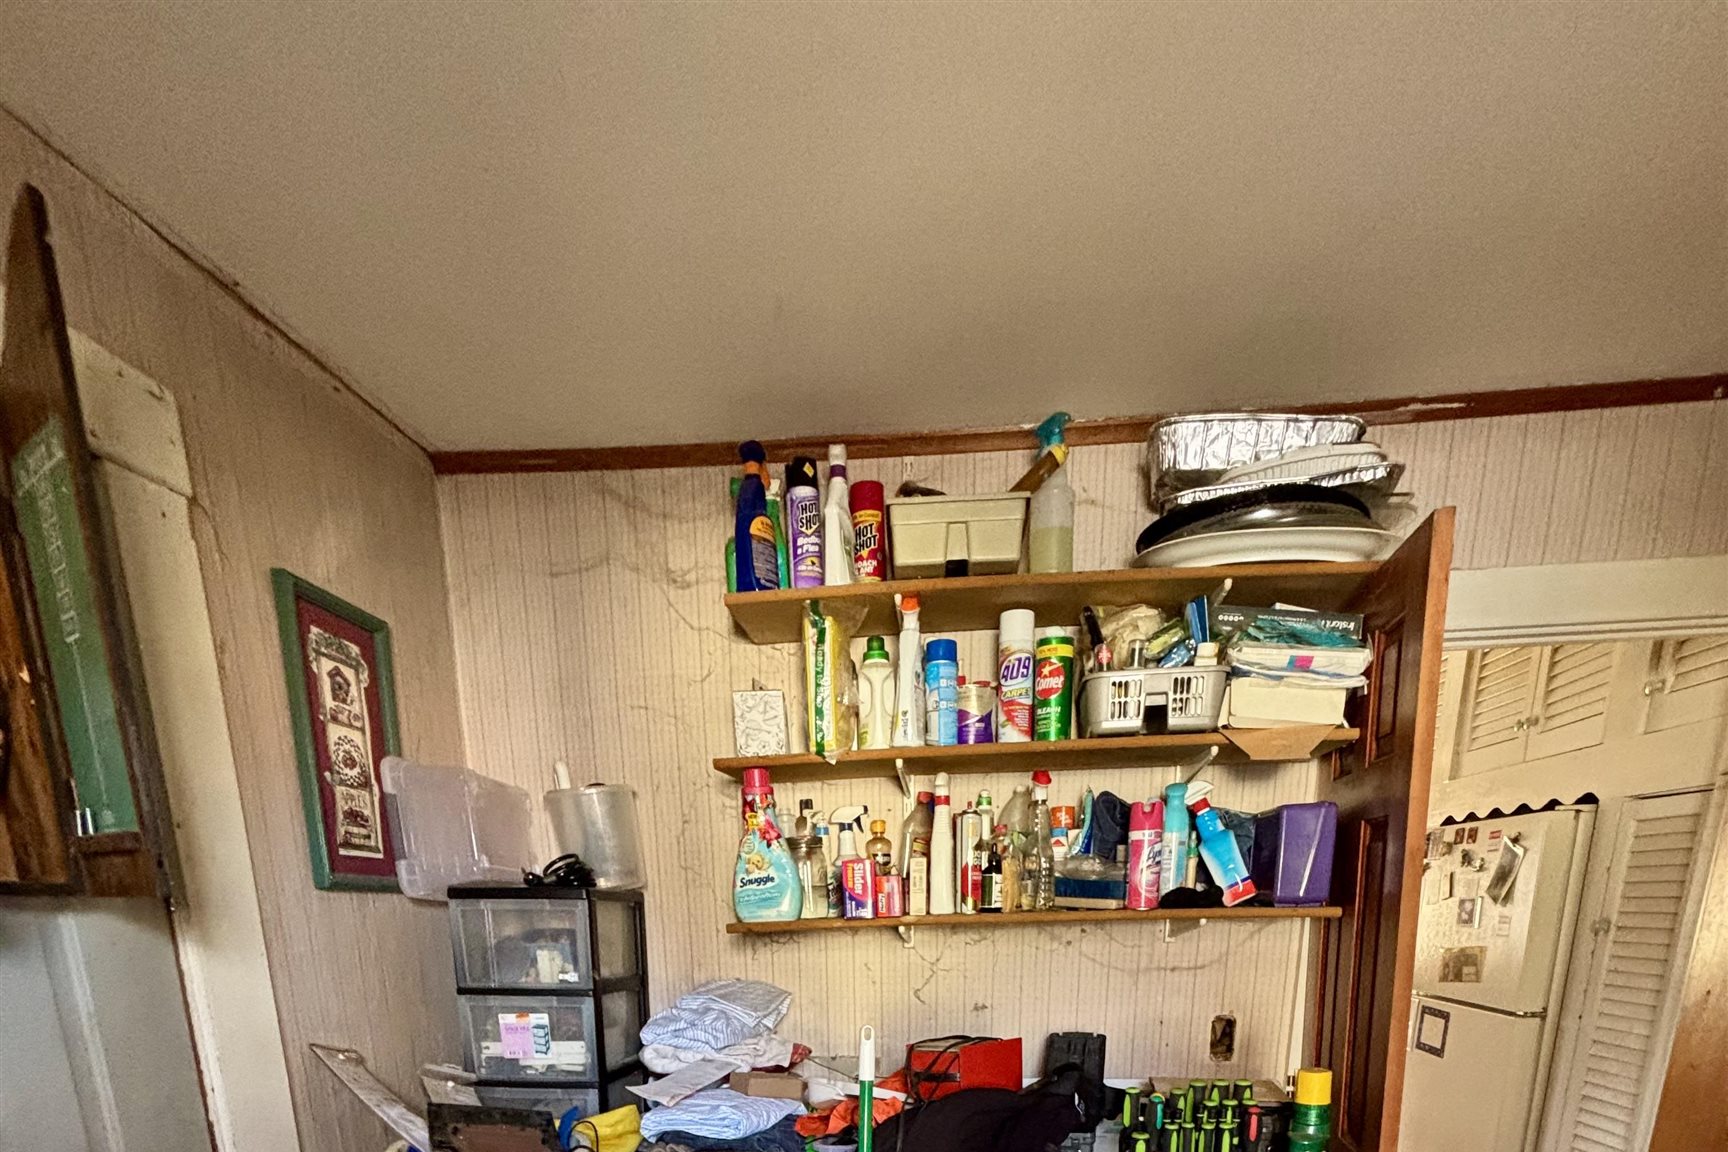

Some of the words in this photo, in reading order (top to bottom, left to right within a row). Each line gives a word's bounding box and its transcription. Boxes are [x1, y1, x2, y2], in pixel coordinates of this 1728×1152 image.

[855, 522, 874, 541] HOT
[855, 534, 878, 555] SHOT
[855, 559, 878, 569] OACH
[1001, 656, 1031, 682] 409
[1035, 676, 1065, 692] Comet
[739, 874, 776, 889] Snuggle
[853, 862, 865, 896] Slider
